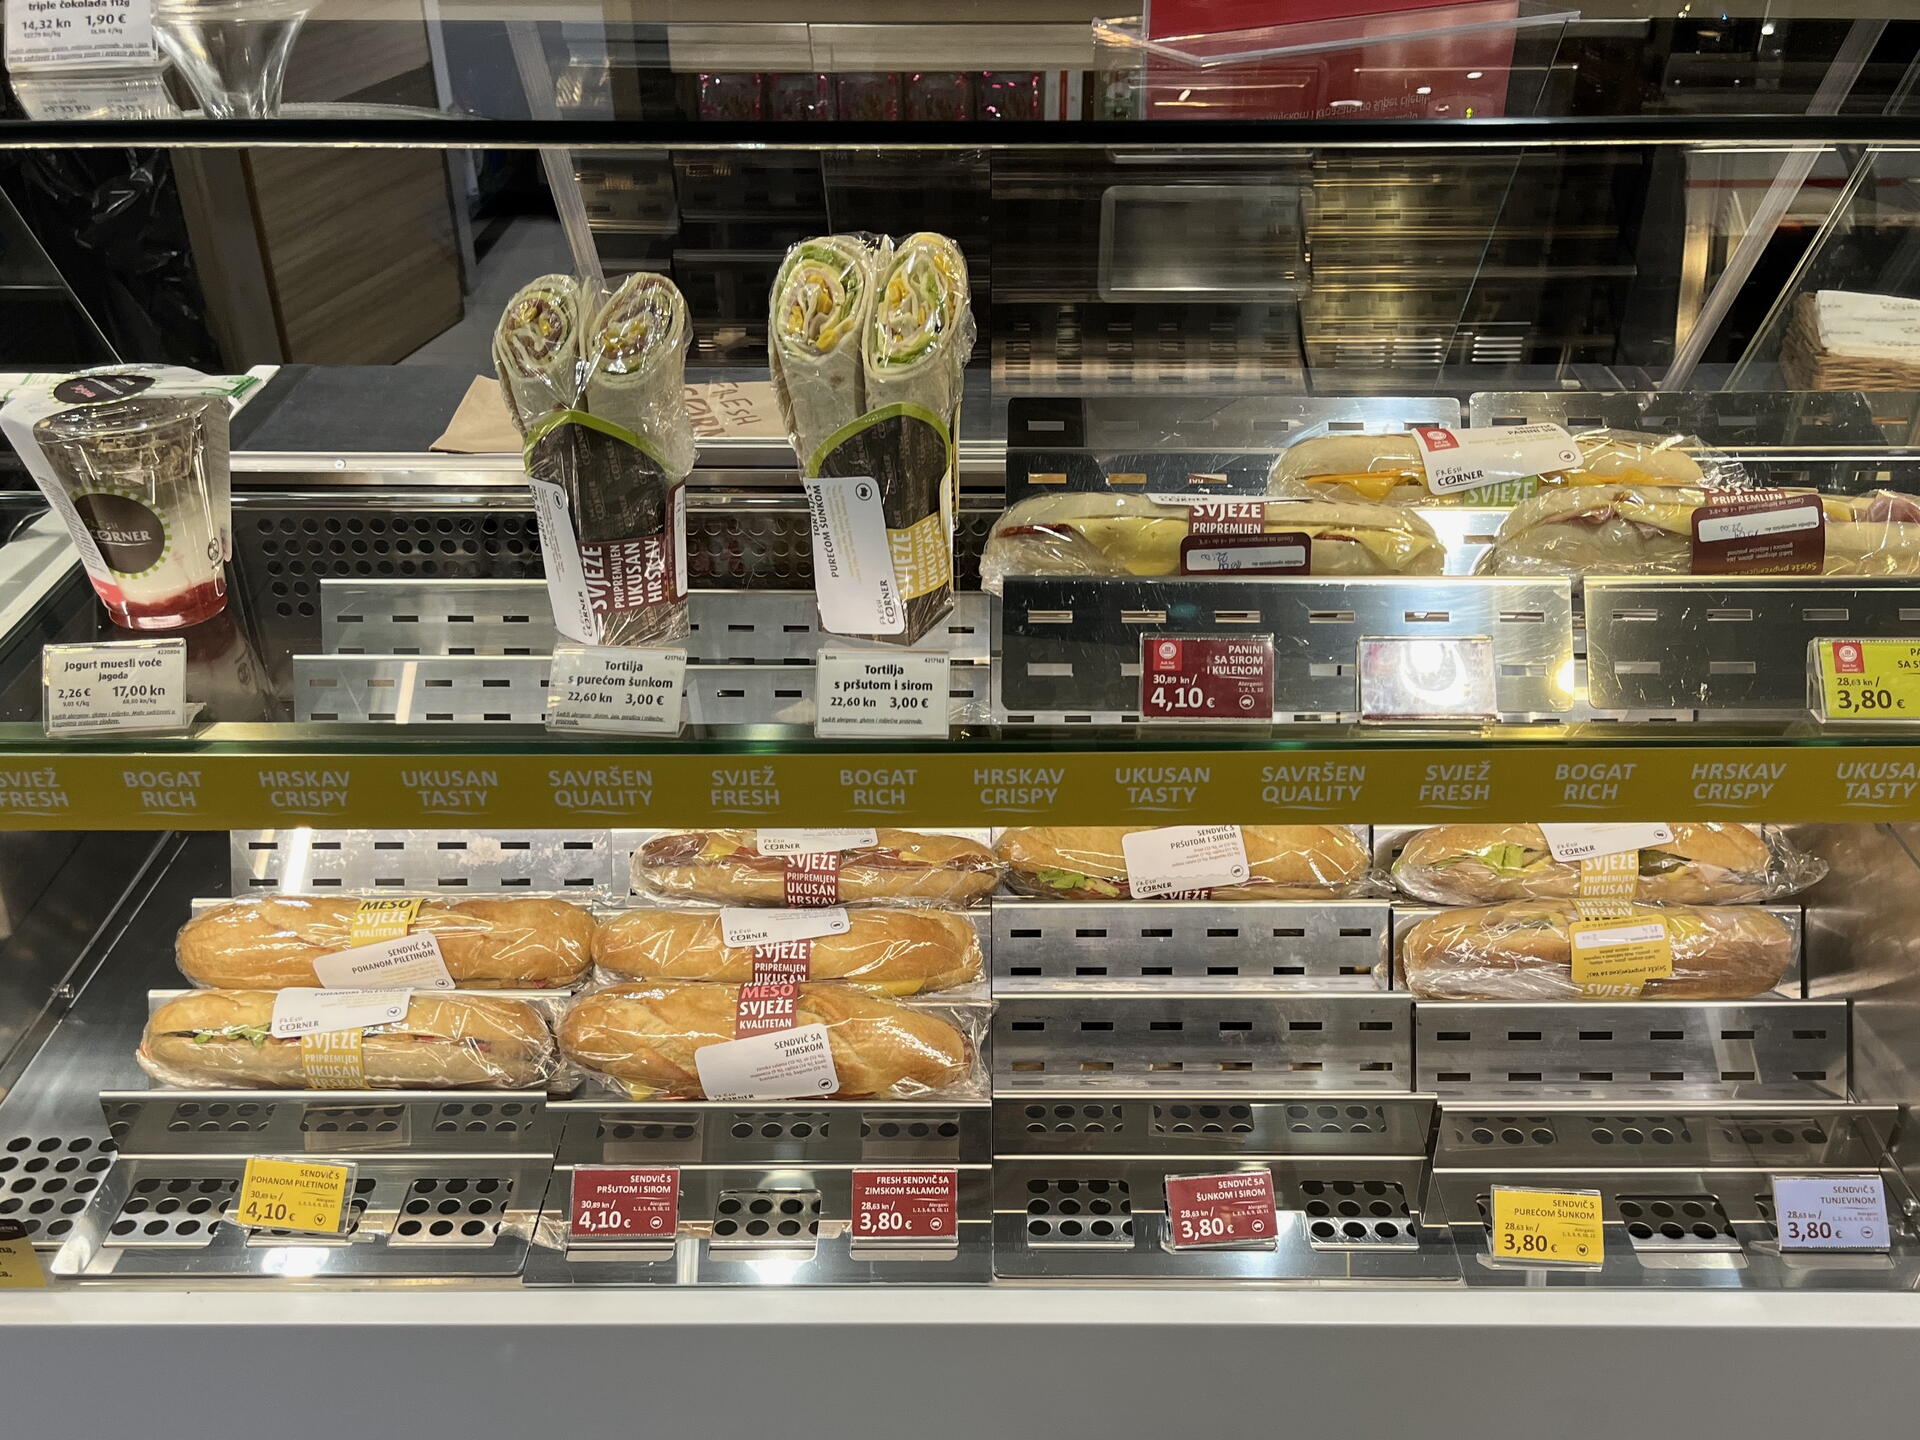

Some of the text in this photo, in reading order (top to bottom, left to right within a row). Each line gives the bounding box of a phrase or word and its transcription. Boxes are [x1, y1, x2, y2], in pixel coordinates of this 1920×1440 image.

[28, 1, 57, 12] triple
[22, 14, 127, 31] 14,32 kn 1,90 €
[1438, 470, 1484, 487] CORNER
[813, 484, 828, 529] ŠUNKOM
[922, 521, 938, 586] UKUSAN
[610, 545, 625, 609] PRIPREMLJEN
[625, 542, 644, 607] UKUSAN
[644, 538, 663, 603] HRSKAV
[881, 579, 896, 625] CORNER
[1228, 645, 1263, 654] PANINI
[64, 658, 162, 672] Jogurt muesli voće
[605, 661, 643, 673] Tortilja
[1214, 655, 1263, 664] SA SIROM
[1897, 660, 1911, 668] SA
[865, 664, 904, 677] Tortilja
[1212, 666, 1263, 675] KULENOM
[576, 674, 673, 688] purećom šunkom
[834, 680, 933, 692] s pršutom sirom
[1153, 674, 1190, 685] 30,89 kn
[1837, 677, 1861, 687] 28,63
[58, 685, 166, 700] 2,26 € 17,00 kn
[567, 692, 665, 706] 22,60 kn 3,00 €
[1150, 686, 1216, 712] 4,10 €
[830, 697, 929, 710] 22,60 kn 3,00 €
[1837, 689, 1906, 713] 3,80 €
[122, 770, 202, 788] BOGAT
[258, 770, 350, 788] HRSKAV
[400, 769, 499, 787] UKUSAN
[548, 765, 653, 787] SAVRŠEN
[711, 765, 776, 787] SVJEŽ
[839, 768, 918, 786] BOGAT
[973, 768, 1065, 785] HRSKAV
[1115, 767, 1210, 784] UKUSAN
[1261, 761, 1366, 783] SAVRŠEN
[1425, 760, 1491, 782] SVJEŽ
[1555, 763, 1637, 780] BOGAT
[1691, 763, 1787, 780] HRSKAV
[141, 790, 197, 807] RICH
[417, 789, 489, 807] TASTY
[711, 789, 781, 806] FRESH
[853, 788, 907, 806] RICH
[979, 787, 1059, 805] CRISPY
[1126, 786, 1198, 804] TASTY
[1262, 785, 1363, 805] QUALITY
[1418, 784, 1491, 801] FRESH
[1563, 783, 1619, 800] RICH
[1693, 783, 1774, 800] CRISPY
[1845, 782, 1919, 799] TASTY
[0, 791, 70, 808] FRESH
[270, 790, 350, 808] CRISPY
[554, 789, 653, 809] QUALITY
[1170, 832, 1237, 850] PRŠUTOM SIROM
[787, 872, 836, 884] PRIPREMLJEN
[787, 882, 836, 896] UKUSAN
[1583, 884, 1634, 896] UKUSAN
[361, 899, 412, 910] MESO
[787, 895, 836, 905] HRSKAV
[1581, 907, 1633, 917] HRSKAV
[354, 927, 405, 937] KVALITETAN
[421, 941, 433, 949] SA
[352, 959, 393, 974] POHANOM
[394, 949, 436, 965] PILETINOM
[755, 963, 806, 974] PRIPREMLJEN
[741, 984, 794, 999] MESO
[1585, 982, 1641, 998] SVJEŽE
[740, 997, 793, 1018] SVJEŽE
[740, 1018, 792, 1030] KVALITETAN
[774, 1032, 822, 1050] SENDVIČ SA
[785, 1042, 824, 1057] ZIMSKOM
[304, 1054, 358, 1064] PRIPREMLJEN
[307, 1065, 360, 1077] UKUSAN
[300, 1169, 333, 1179] SENDVIČ
[630, 1174, 665, 1183] SENDVIČ
[876, 1175, 949, 1184] FRESH SENDVIČ SA
[251, 1176, 338, 1190] POHANOM PILETINOM
[597, 1185, 637, 1193] PRŠUTOM
[865, 1187, 949, 1195] ZIMSKOM SALAMOM
[1218, 1178, 1265, 1189] SENDVIČ SA
[1833, 1185, 1869, 1194] SENDVIČ
[1197, 1188, 1266, 1202] ŠUNKOM SIROM
[1821, 1196, 1877, 1205] TUNJEVINOM
[246, 1202, 287, 1221] 4,10
[289, 1213, 296, 1221] €
[581, 1200, 600, 1209] 30,89
[861, 1202, 880, 1210] 28,63
[1552, 1199, 1588, 1208] SENDVIČ
[1180, 1209, 1199, 1218] 28,63
[1514, 1207, 1595, 1219] PUREĆOM ŠUNKOM
[1787, 1210, 1807, 1219] 28,63
[579, 1211, 631, 1232] 4,10 €
[860, 1212, 912, 1233] 3,80 €
[1181, 1218, 1234, 1240] 3,80 €
[1505, 1222, 1524, 1231] 28,63
[1787, 1221, 1843, 1242] 3,80 €
[1504, 1233, 1558, 1254] 3,80 €
